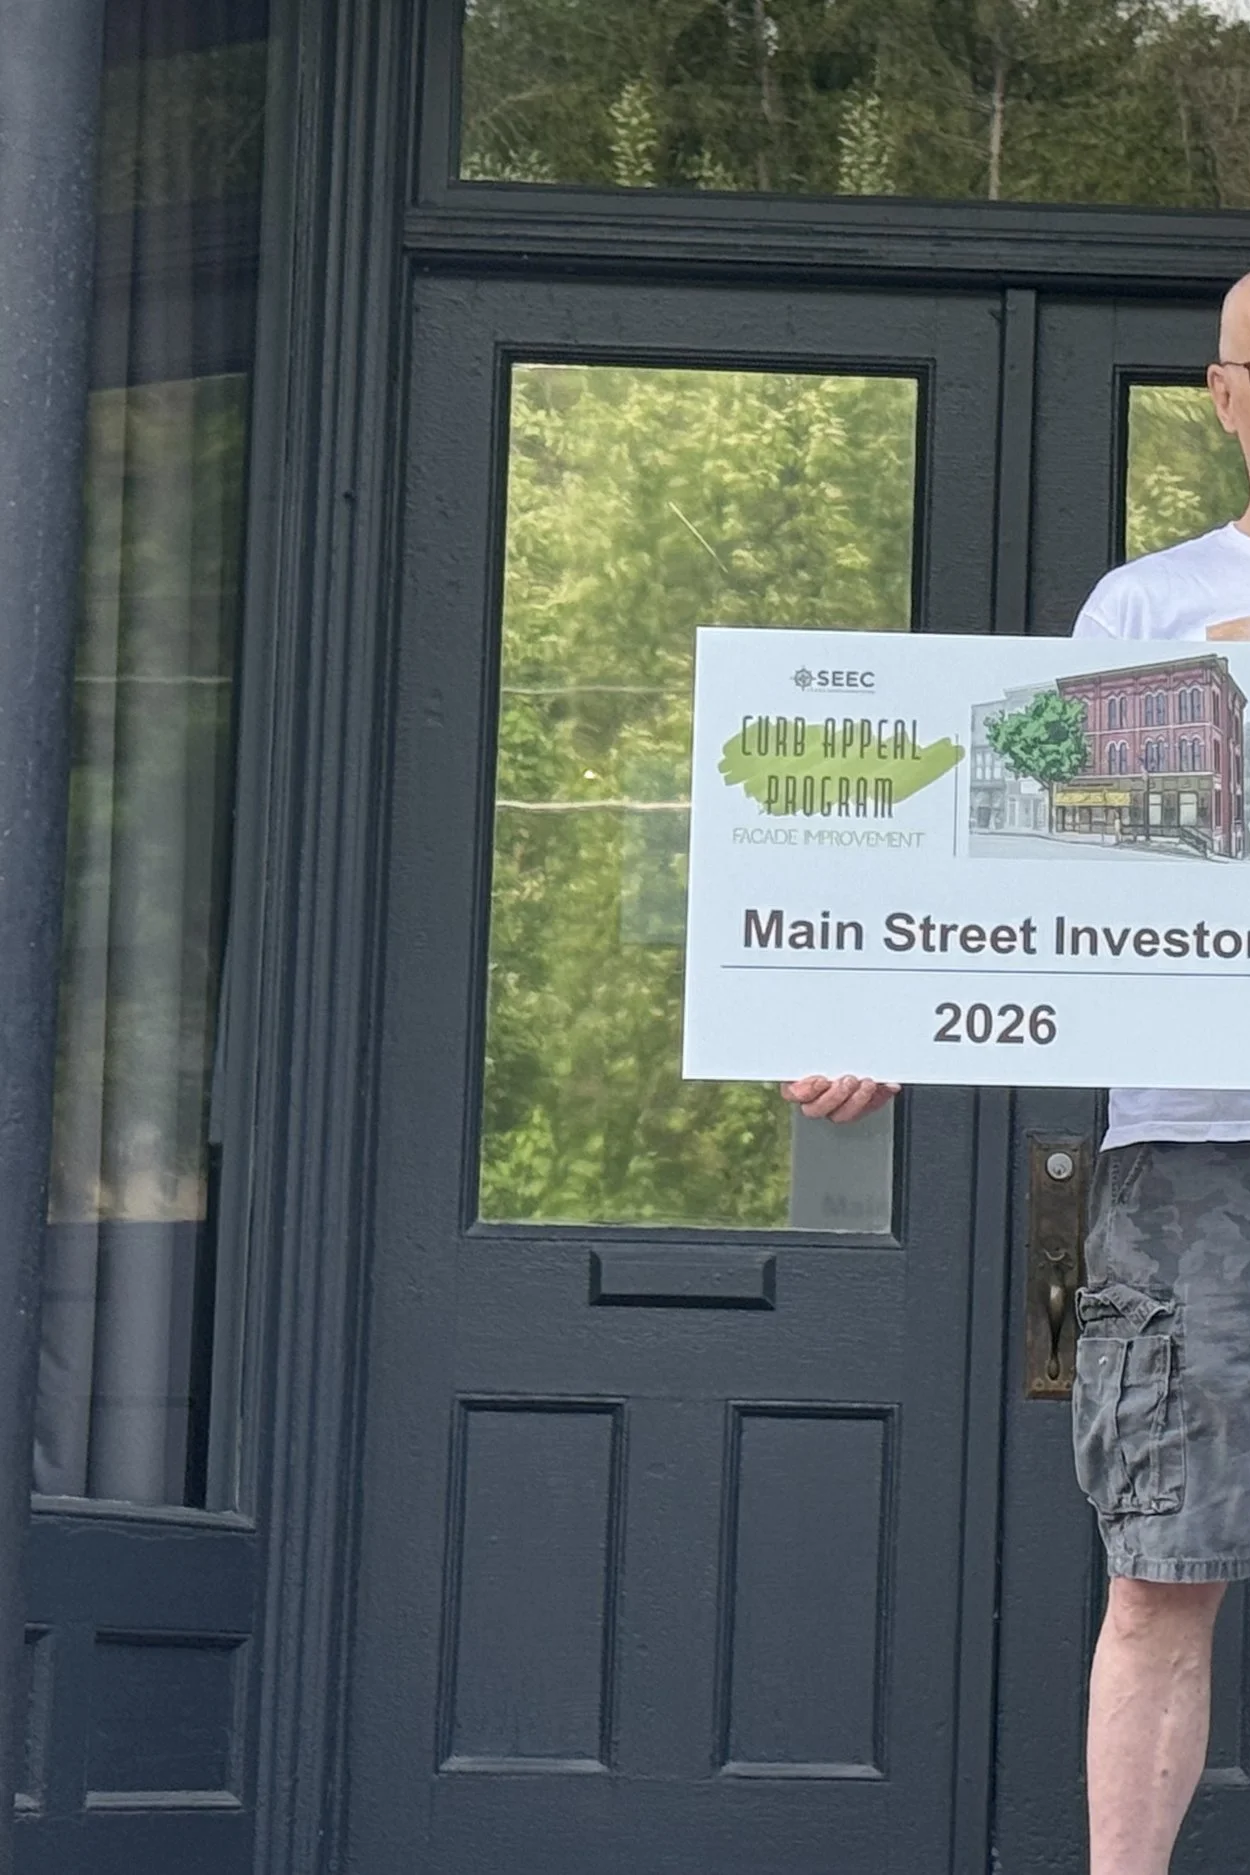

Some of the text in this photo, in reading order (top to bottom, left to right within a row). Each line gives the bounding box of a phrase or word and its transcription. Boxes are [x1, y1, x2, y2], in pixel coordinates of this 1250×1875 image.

[817, 670, 876, 688] SEEC
[741, 715, 922, 760] CURB APPEAL
[765, 775, 894, 818] PROGRAM
[732, 827, 926, 849] FACADE IMPROVEMENT
[743, 908, 864, 951] Main
[882, 911, 1038, 955] Street
[933, 1002, 1058, 1046] 2026
